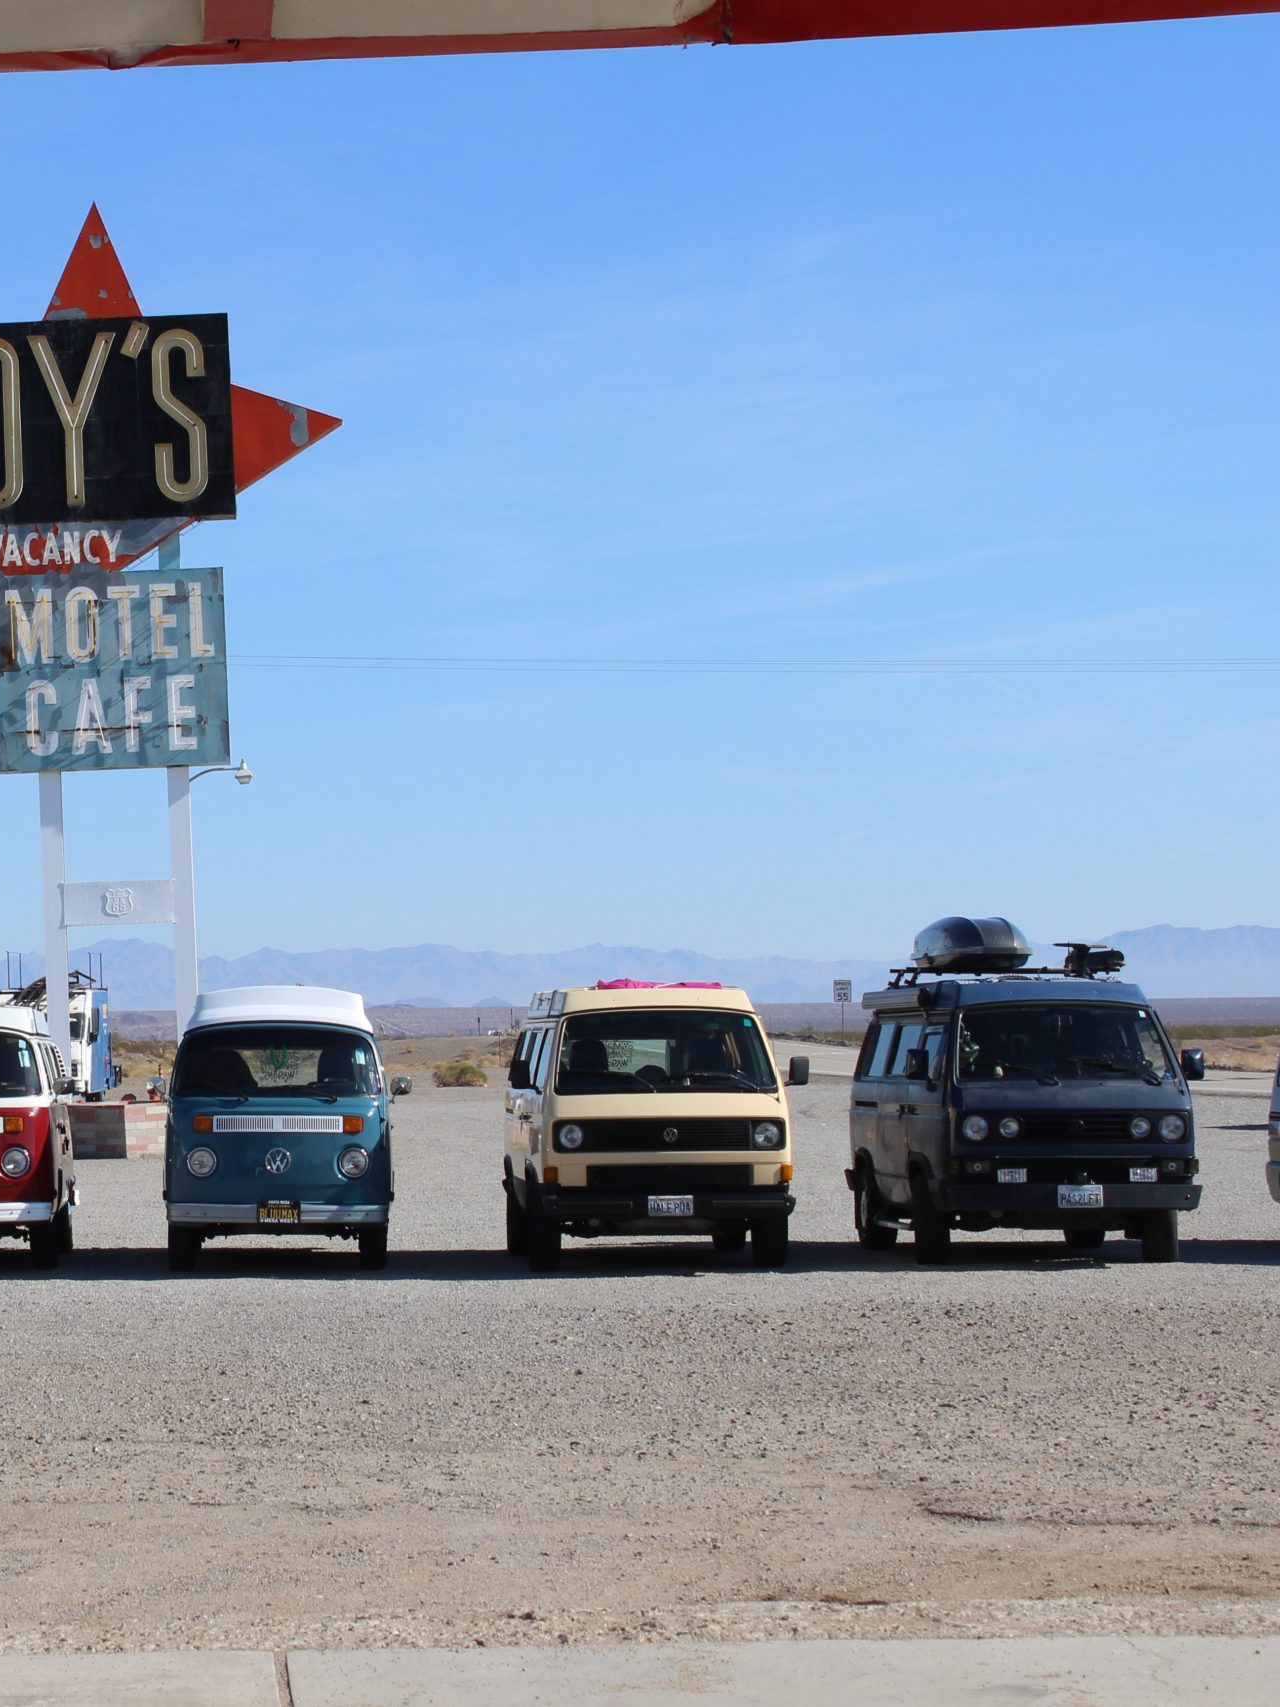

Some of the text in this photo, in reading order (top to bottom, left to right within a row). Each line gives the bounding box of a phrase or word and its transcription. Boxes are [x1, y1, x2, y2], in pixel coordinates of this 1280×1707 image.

[5, 582, 215, 664] MOTEL
[25, 674, 197, 756] CAFE
[837, 992, 849, 1001] 55
[265, 1147, 291, 1173] VW
